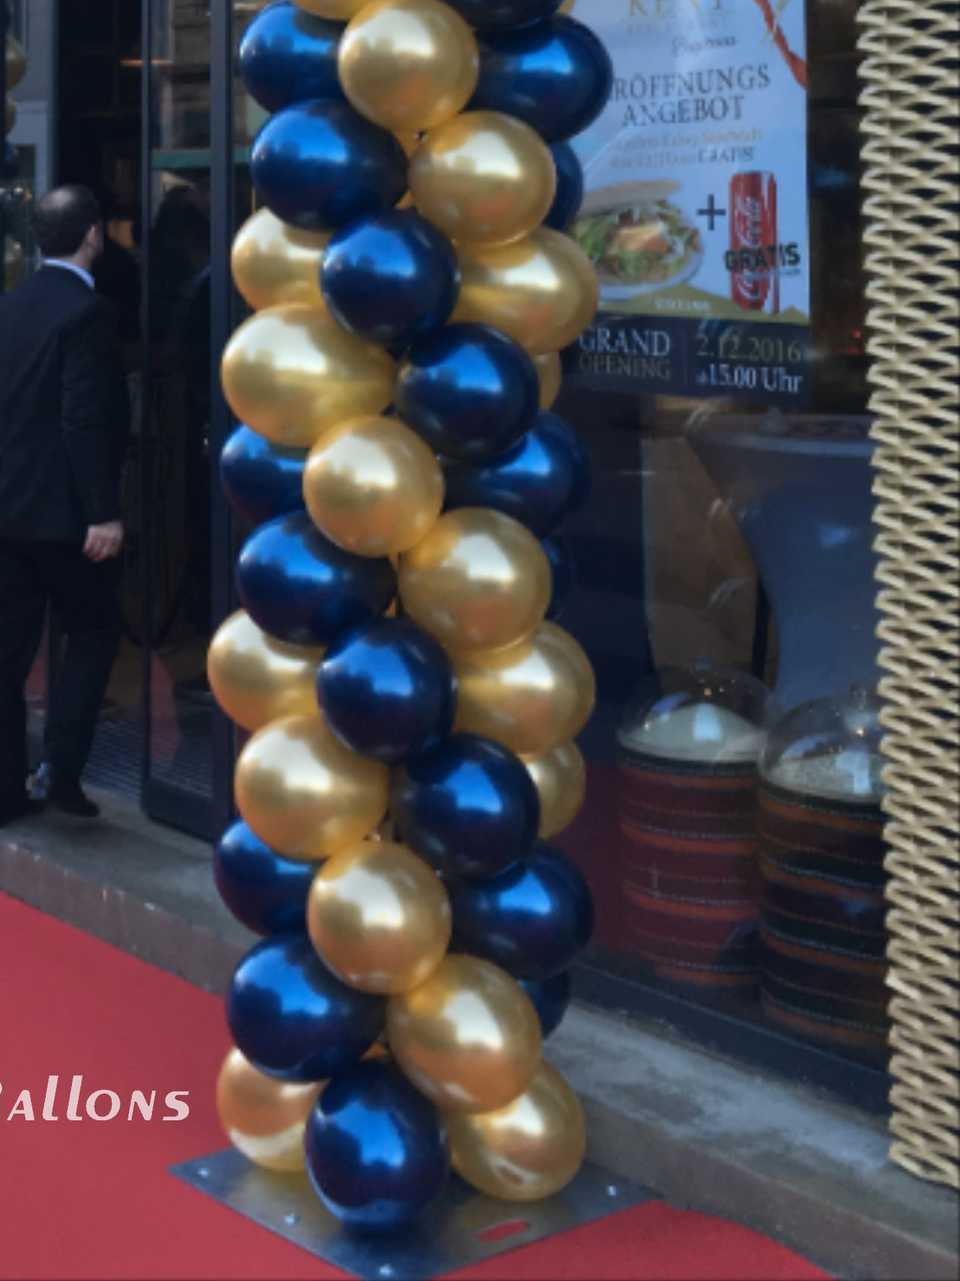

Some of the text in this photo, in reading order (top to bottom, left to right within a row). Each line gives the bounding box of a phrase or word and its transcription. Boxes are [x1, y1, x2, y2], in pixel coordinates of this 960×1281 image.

[611, 63, 771, 102] RÖFFNUNGS
[622, 95, 745, 127] ANGEBOT
[724, 242, 801, 272] GRATIS
[578, 327, 672, 357] GRAND
[579, 353, 672, 381] OPENING
[761, 366, 803, 394] Uhr
